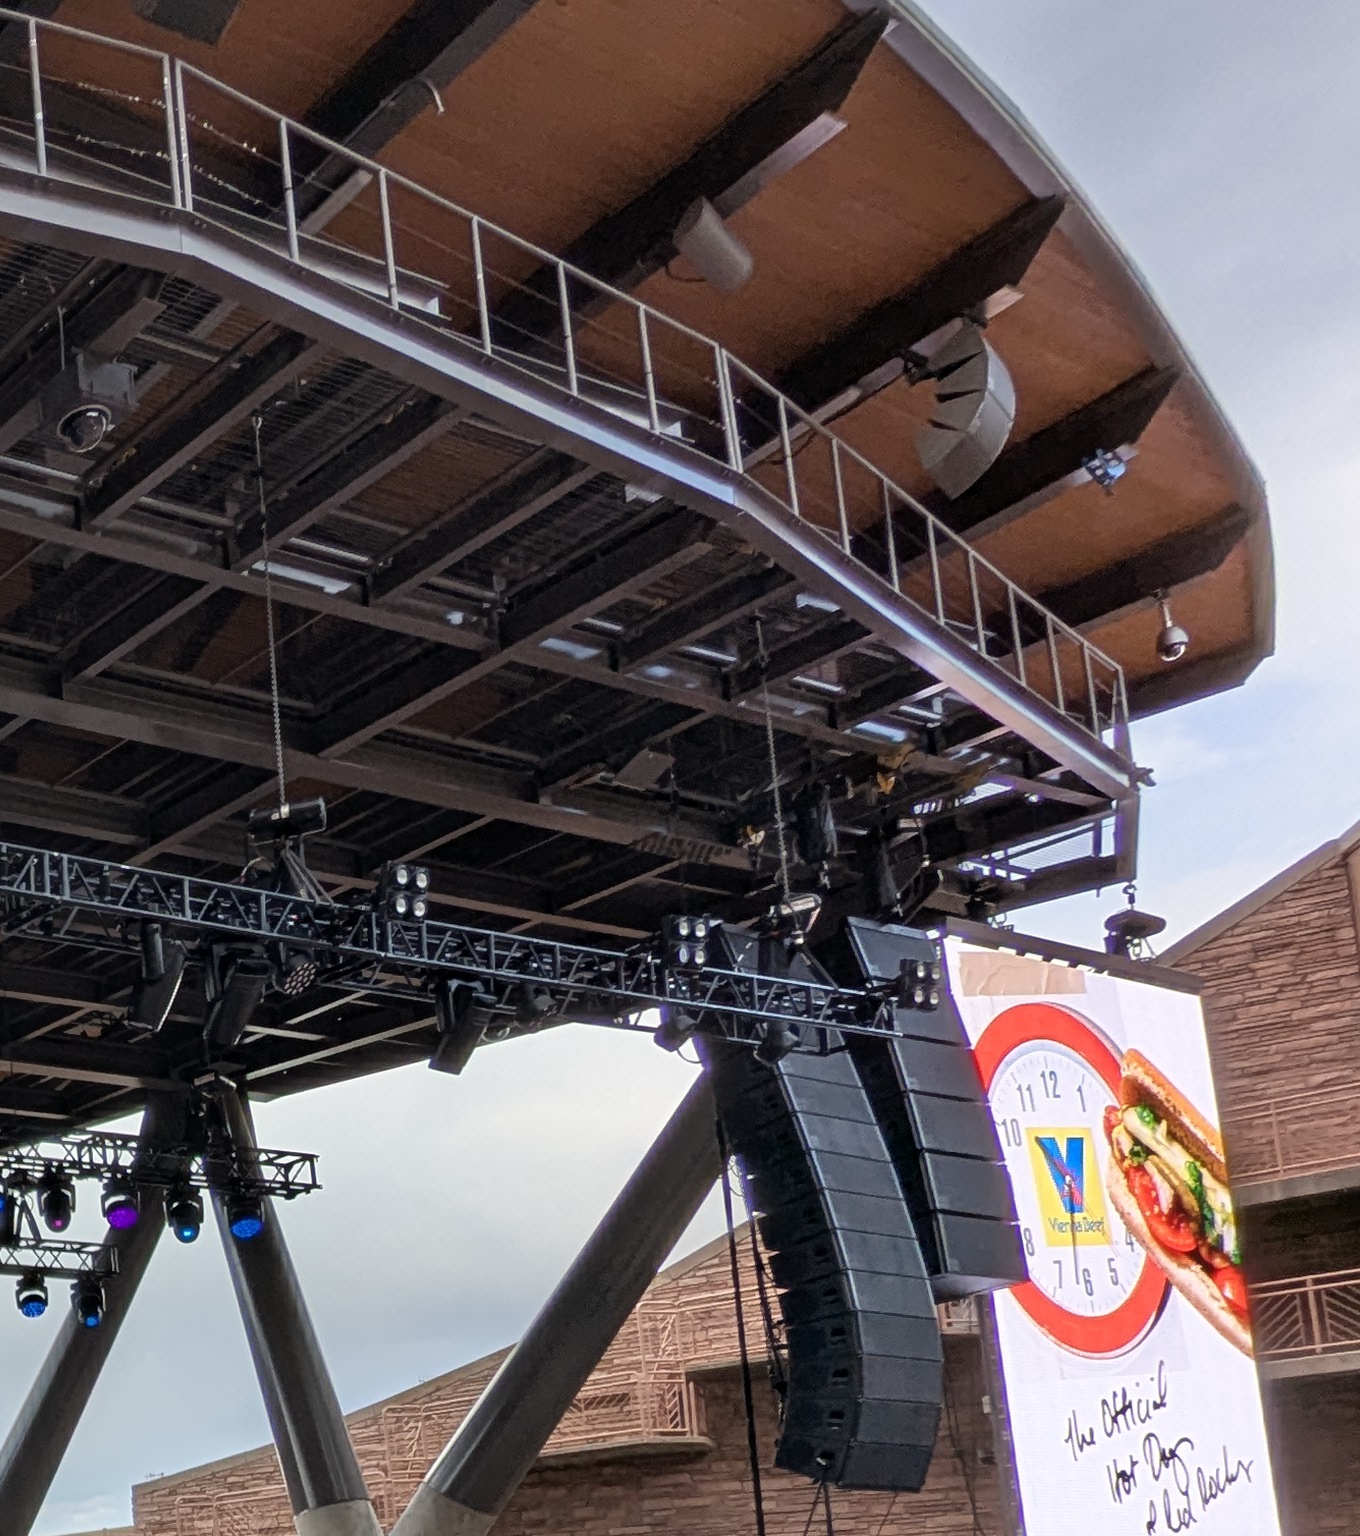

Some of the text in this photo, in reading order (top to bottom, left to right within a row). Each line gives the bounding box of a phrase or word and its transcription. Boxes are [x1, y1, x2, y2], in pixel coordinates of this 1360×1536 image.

[1016, 1083, 1036, 1112] 11
[1040, 1070, 1061, 1098] 12
[1077, 1085, 1086, 1112] 1
[1001, 1118, 1022, 1147] 10
[1023, 1228, 1036, 1257] 8
[1053, 1260, 1063, 1289] 7
[1083, 1268, 1094, 1297] 6
[1107, 1258, 1119, 1286] 5
[1106, 1431, 1194, 1504] Hot Dog
